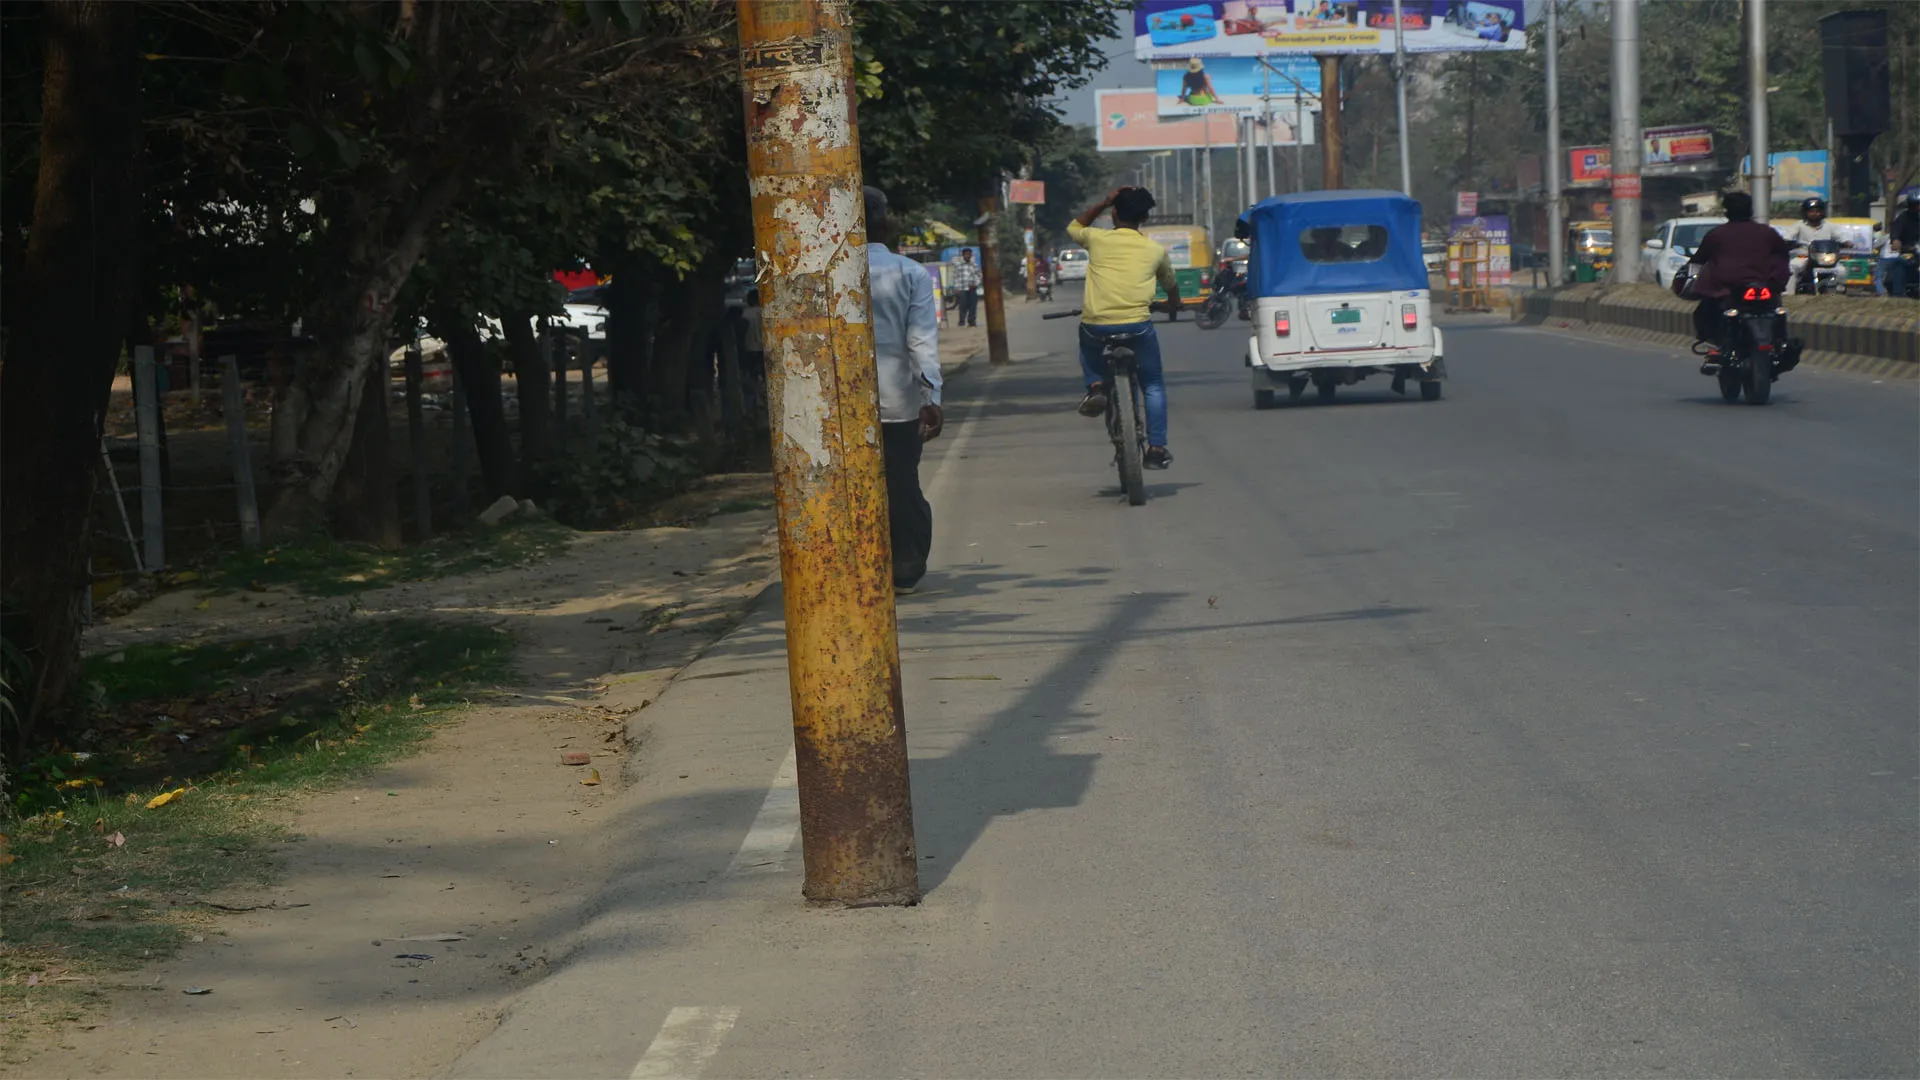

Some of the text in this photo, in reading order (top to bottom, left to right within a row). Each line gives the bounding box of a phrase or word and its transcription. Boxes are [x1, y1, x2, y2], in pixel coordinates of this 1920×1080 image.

[1274, 32, 1377, 44] Introducing Play Group
